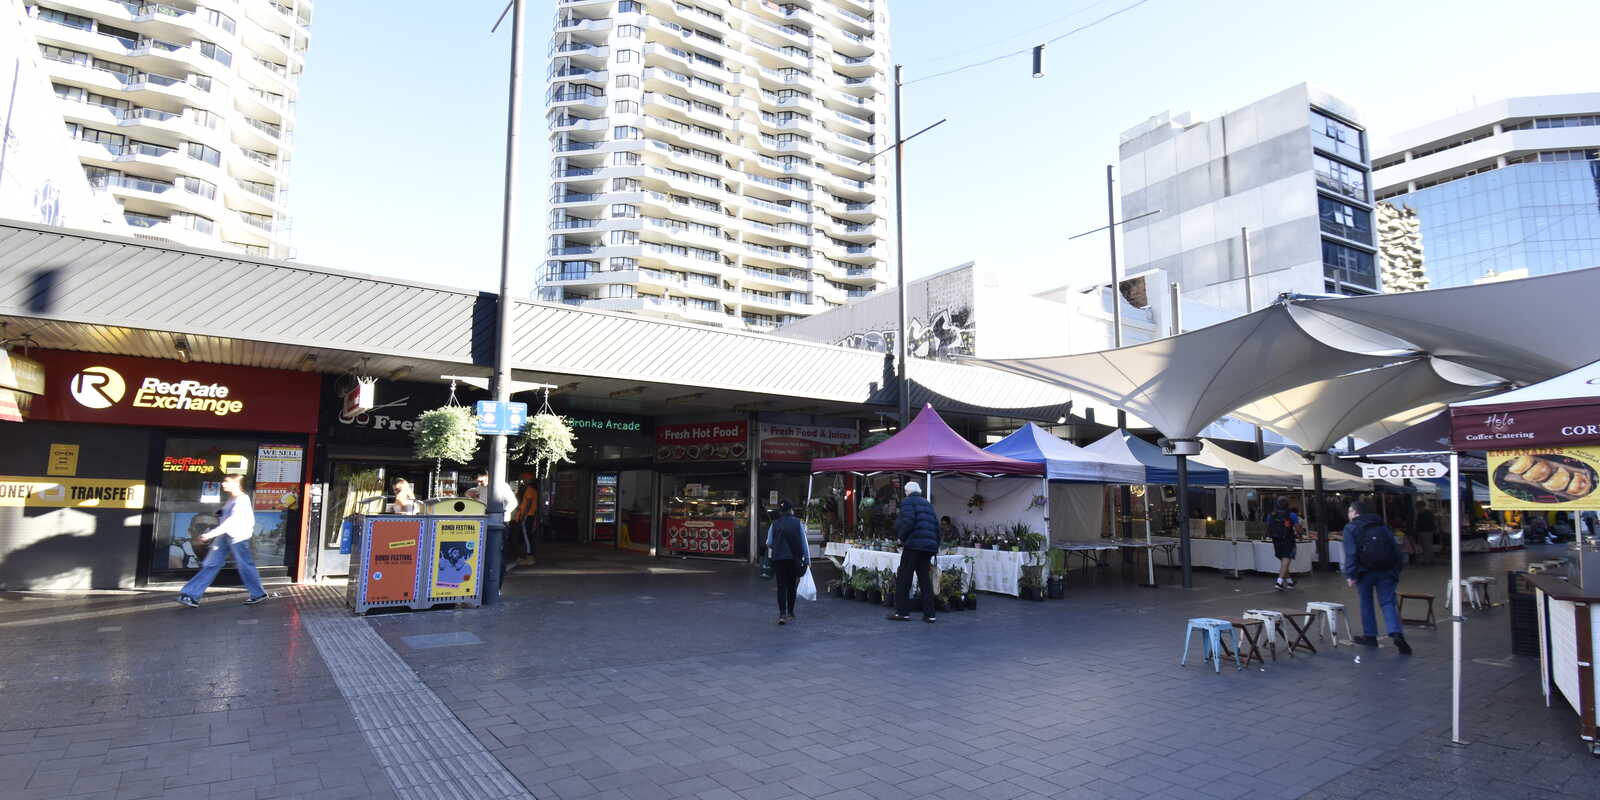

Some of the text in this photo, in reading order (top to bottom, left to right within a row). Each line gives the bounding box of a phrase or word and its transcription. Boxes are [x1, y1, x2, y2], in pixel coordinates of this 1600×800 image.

[142, 377, 229, 398] RedRate
[132, 388, 243, 416] Exchange
[569, 417, 640, 431] Bronka Arcade
[664, 425, 739, 440] Fresh Hot Food
[770, 426, 794, 436] Fresh
[796, 428, 817, 437] Food
[1495, 432, 1535, 440] Catering
[162, 461, 214, 474] Exchange
[1377, 465, 1437, 478] Coffee
[70, 485, 136, 501] TRANSFER
